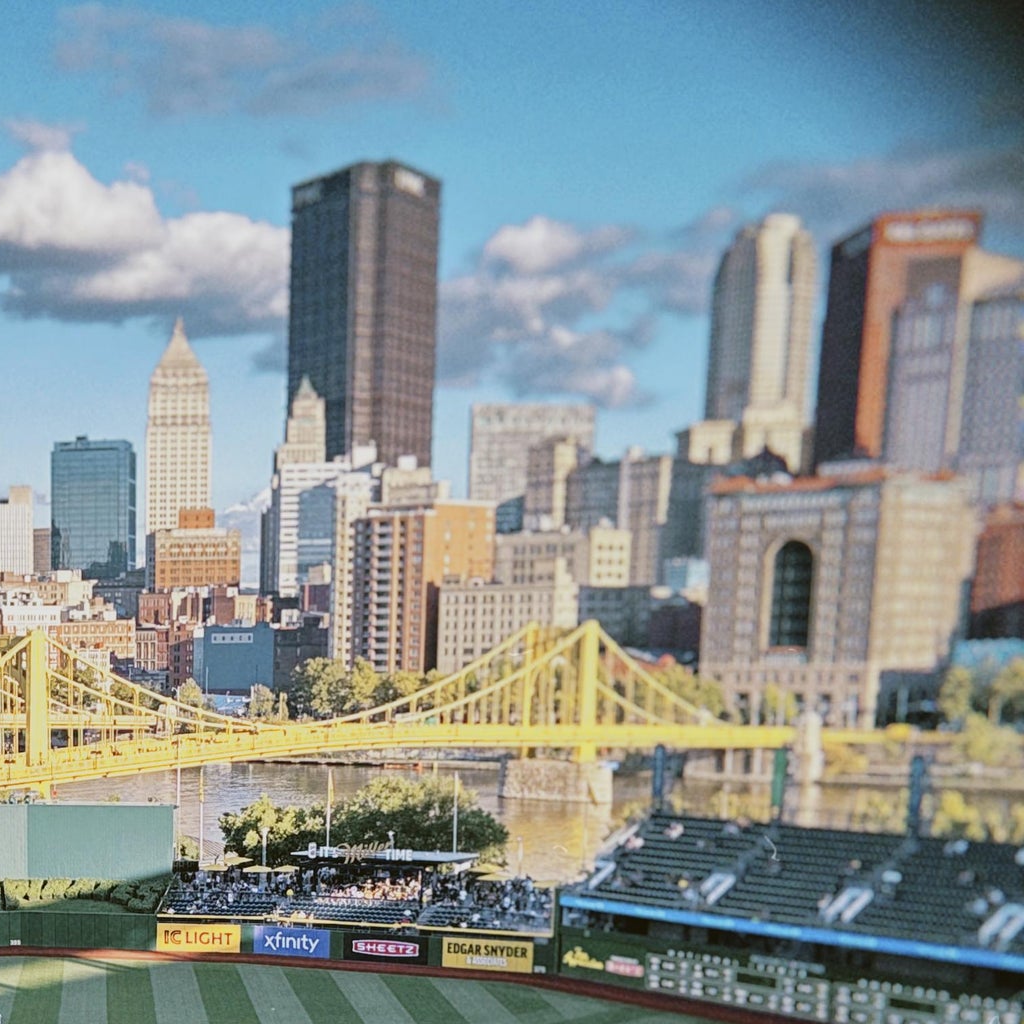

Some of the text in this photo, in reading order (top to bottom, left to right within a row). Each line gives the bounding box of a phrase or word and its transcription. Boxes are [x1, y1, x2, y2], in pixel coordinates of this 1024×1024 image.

[336, 841, 395, 864] Miller
[385, 849, 413, 861] TIME
[185, 932, 233, 945] LIGHT
[264, 931, 320, 953] xfinity
[357, 941, 414, 954] SHEETZ
[447, 942, 528, 958] EDGAR SNYDER
